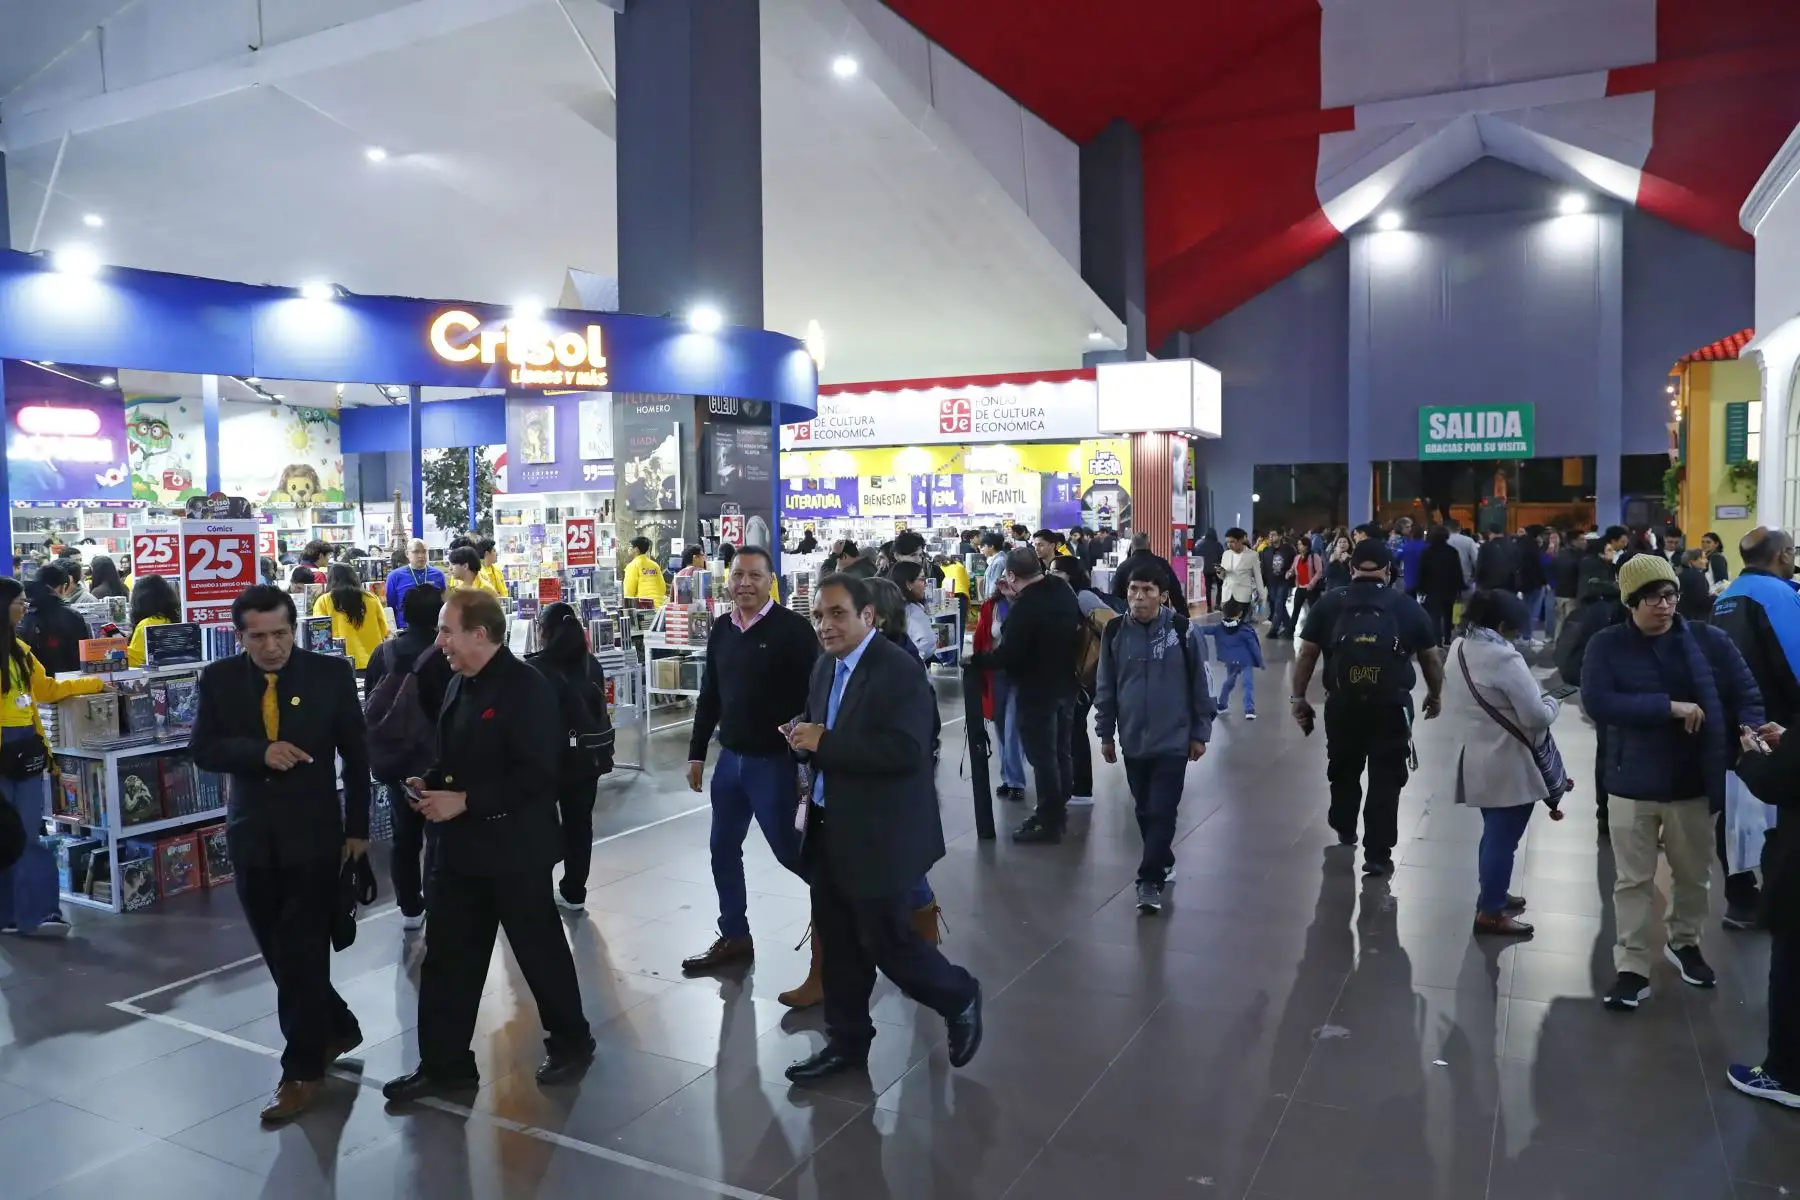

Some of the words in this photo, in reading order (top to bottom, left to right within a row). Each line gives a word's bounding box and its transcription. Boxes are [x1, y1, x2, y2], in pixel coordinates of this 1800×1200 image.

[430, 310, 607, 368] Crisol
[976, 396, 1017, 407] FONDO
[636, 404, 671, 414] HOMERO
[976, 410, 989, 419] DE
[994, 408, 1045, 419] CULTURA
[814, 418, 827, 428] DE
[829, 416, 876, 427] CULTURA
[976, 420, 1045, 432] ECONÓMICA
[1429, 411, 1523, 440] SALIDA
[1424, 443, 1463, 454] GRACIAS
[1464, 442, 1482, 453] POR
[1483, 442, 1495, 452] SU
[1497, 442, 1527, 452] VISITA
[1089, 459, 1122, 475] FIESTA
[785, 493, 842, 509] LITERATURA
[864, 494, 906, 507] BIENESTAR
[982, 489, 1027, 505] INFANTIL
[206, 525, 233, 533] Cómics
[1349, 665, 1381, 684] CAT
